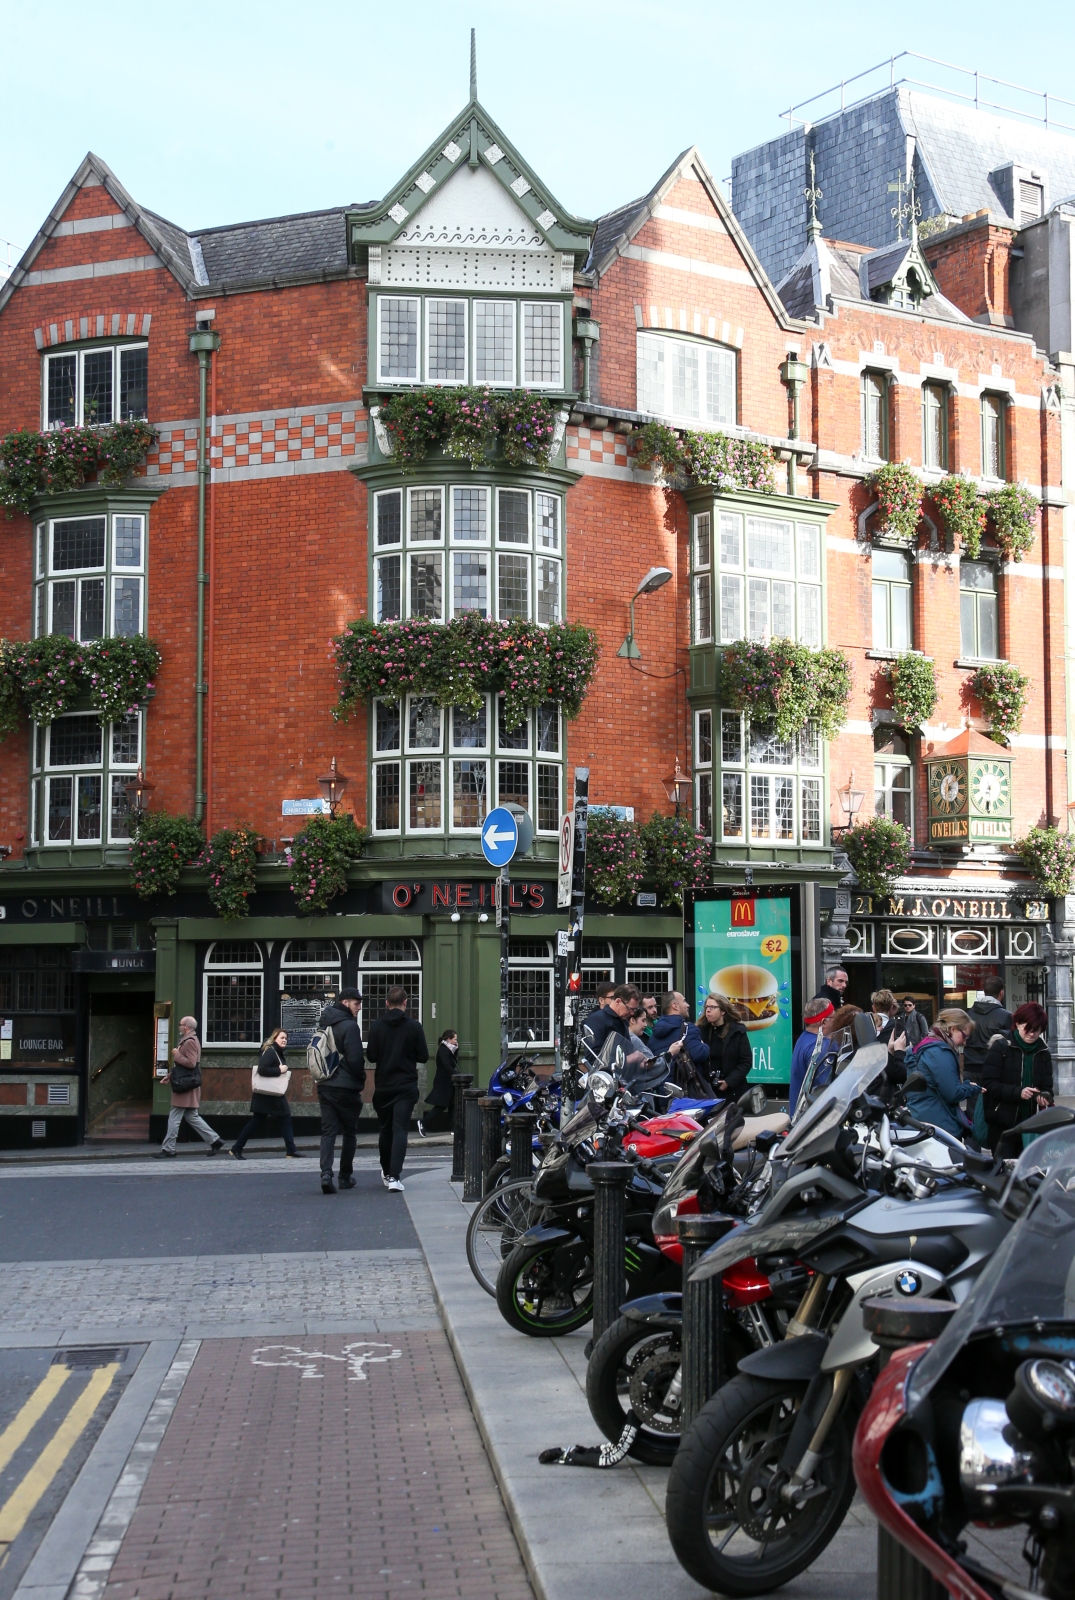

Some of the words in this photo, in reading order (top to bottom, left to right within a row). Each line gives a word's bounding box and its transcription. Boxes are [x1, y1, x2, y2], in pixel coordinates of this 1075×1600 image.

[627, 810, 633, 818] 2
[931, 820, 968, 838] O'NEILL'S
[971, 819, 1011, 838] O'NEILL'S
[22, 897, 124, 917] O'NEILL
[932, 898, 1012, 918] O'NEILL
[765, 939, 782, 953] €2
[106, 959, 145, 968] LUNGE
[19, 1039, 47, 1050] LOUNGE
[48, 1039, 63, 1050] BAR
[752, 1046, 775, 1070] EAL
